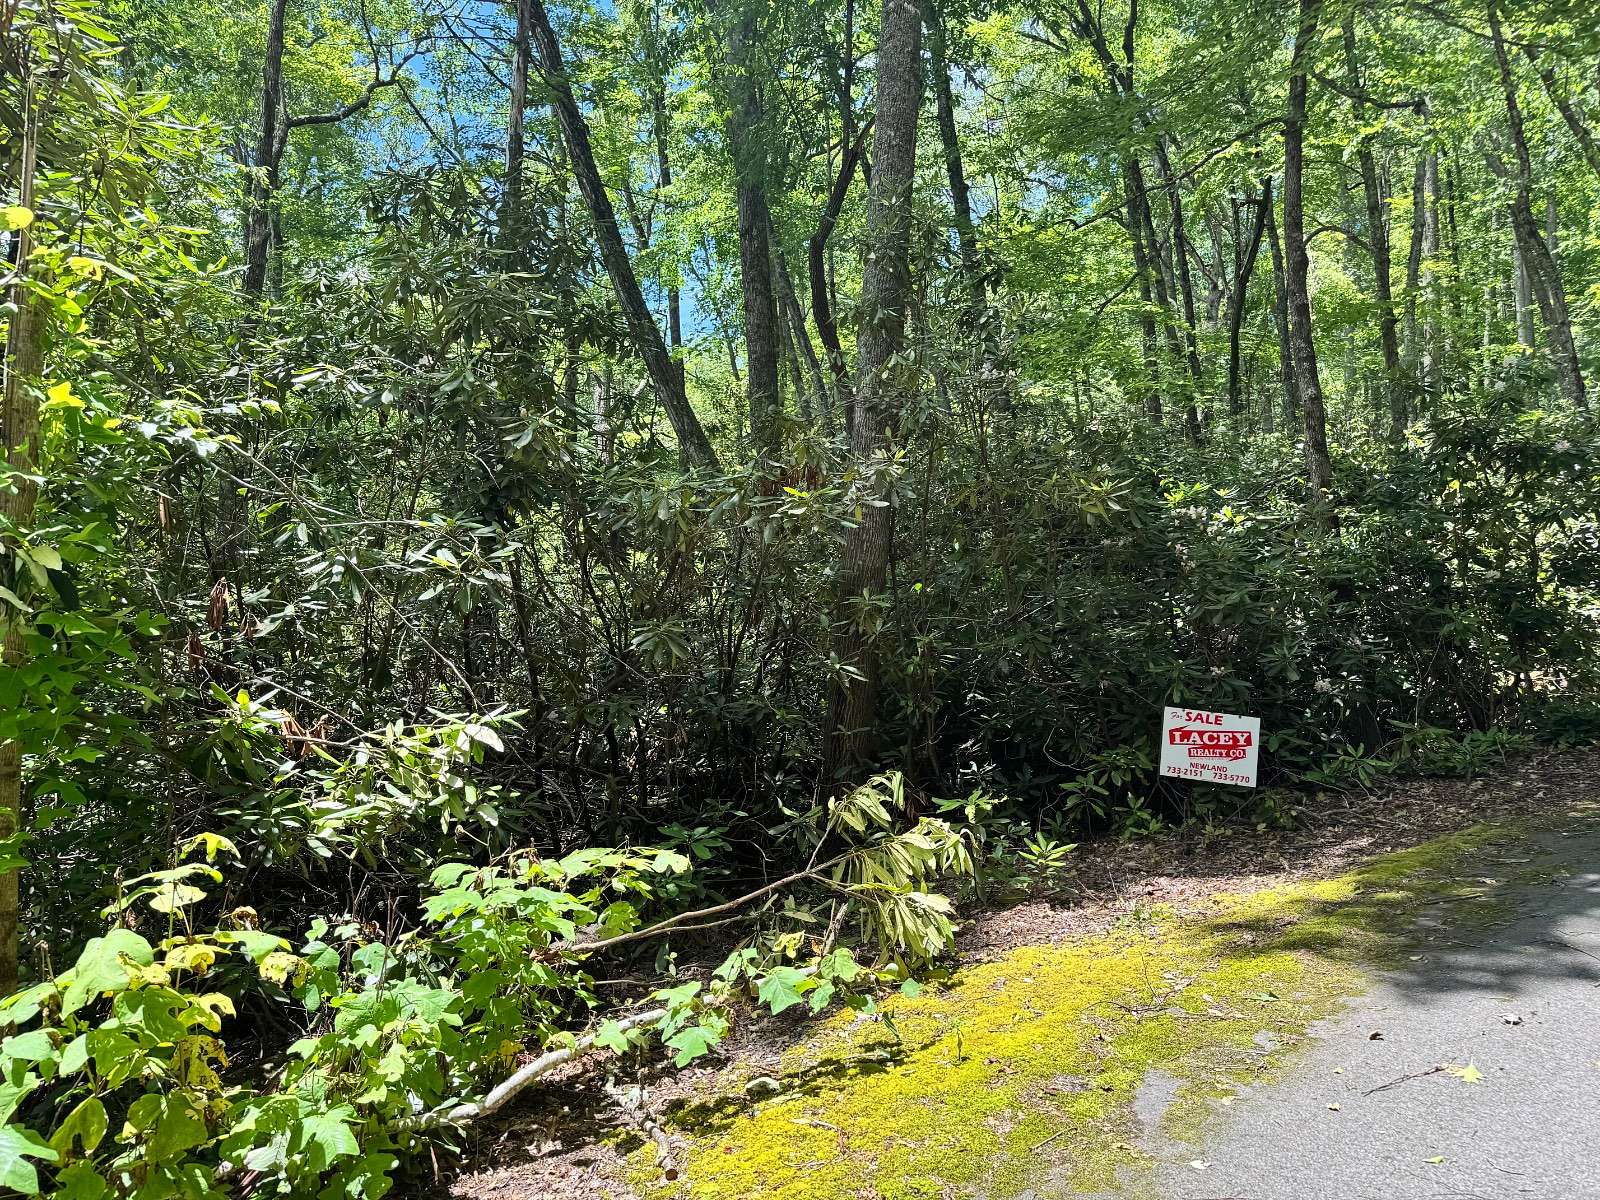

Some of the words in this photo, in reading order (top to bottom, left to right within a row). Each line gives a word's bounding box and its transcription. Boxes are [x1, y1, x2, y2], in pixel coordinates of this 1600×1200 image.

[1185, 711, 1223, 726] SALE
[1173, 731, 1250, 745] LACEY
[1190, 748, 1228, 757] REALTY
[1229, 749, 1246, 758] CO.
[1189, 762, 1228, 773] NEWLAND
[1167, 766, 1203, 777] 733-2151
[1213, 772, 1250, 784] 733-5770
